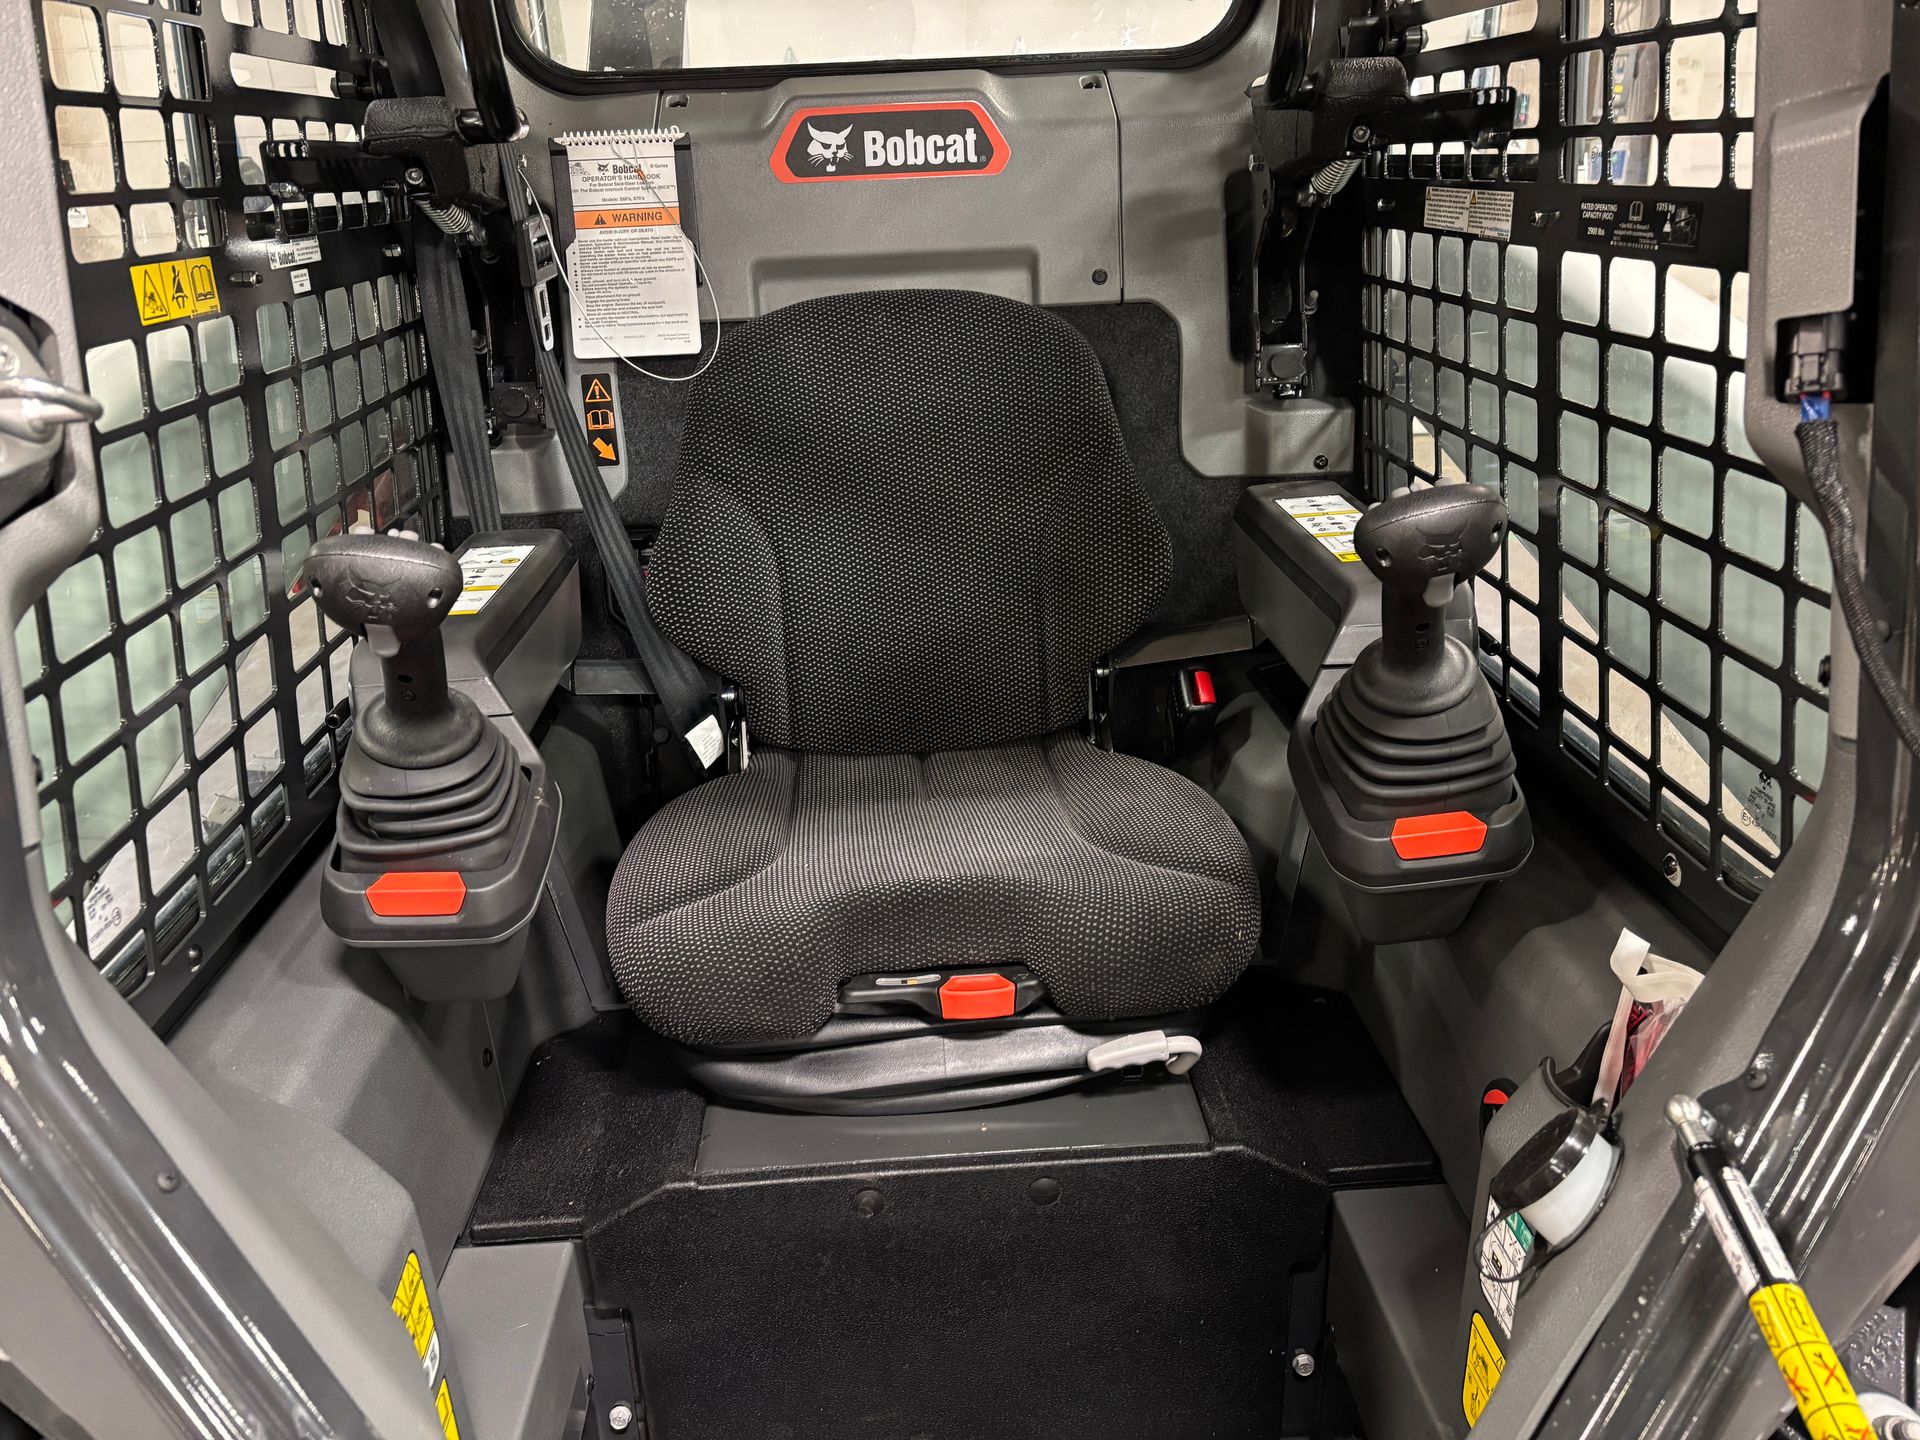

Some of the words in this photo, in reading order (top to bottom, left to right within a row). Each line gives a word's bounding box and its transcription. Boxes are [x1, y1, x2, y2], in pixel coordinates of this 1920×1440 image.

[864, 128, 978, 167] Bobcat
[1595, 203, 1617, 212] OPERATING
[612, 212, 662, 222] WARNING
